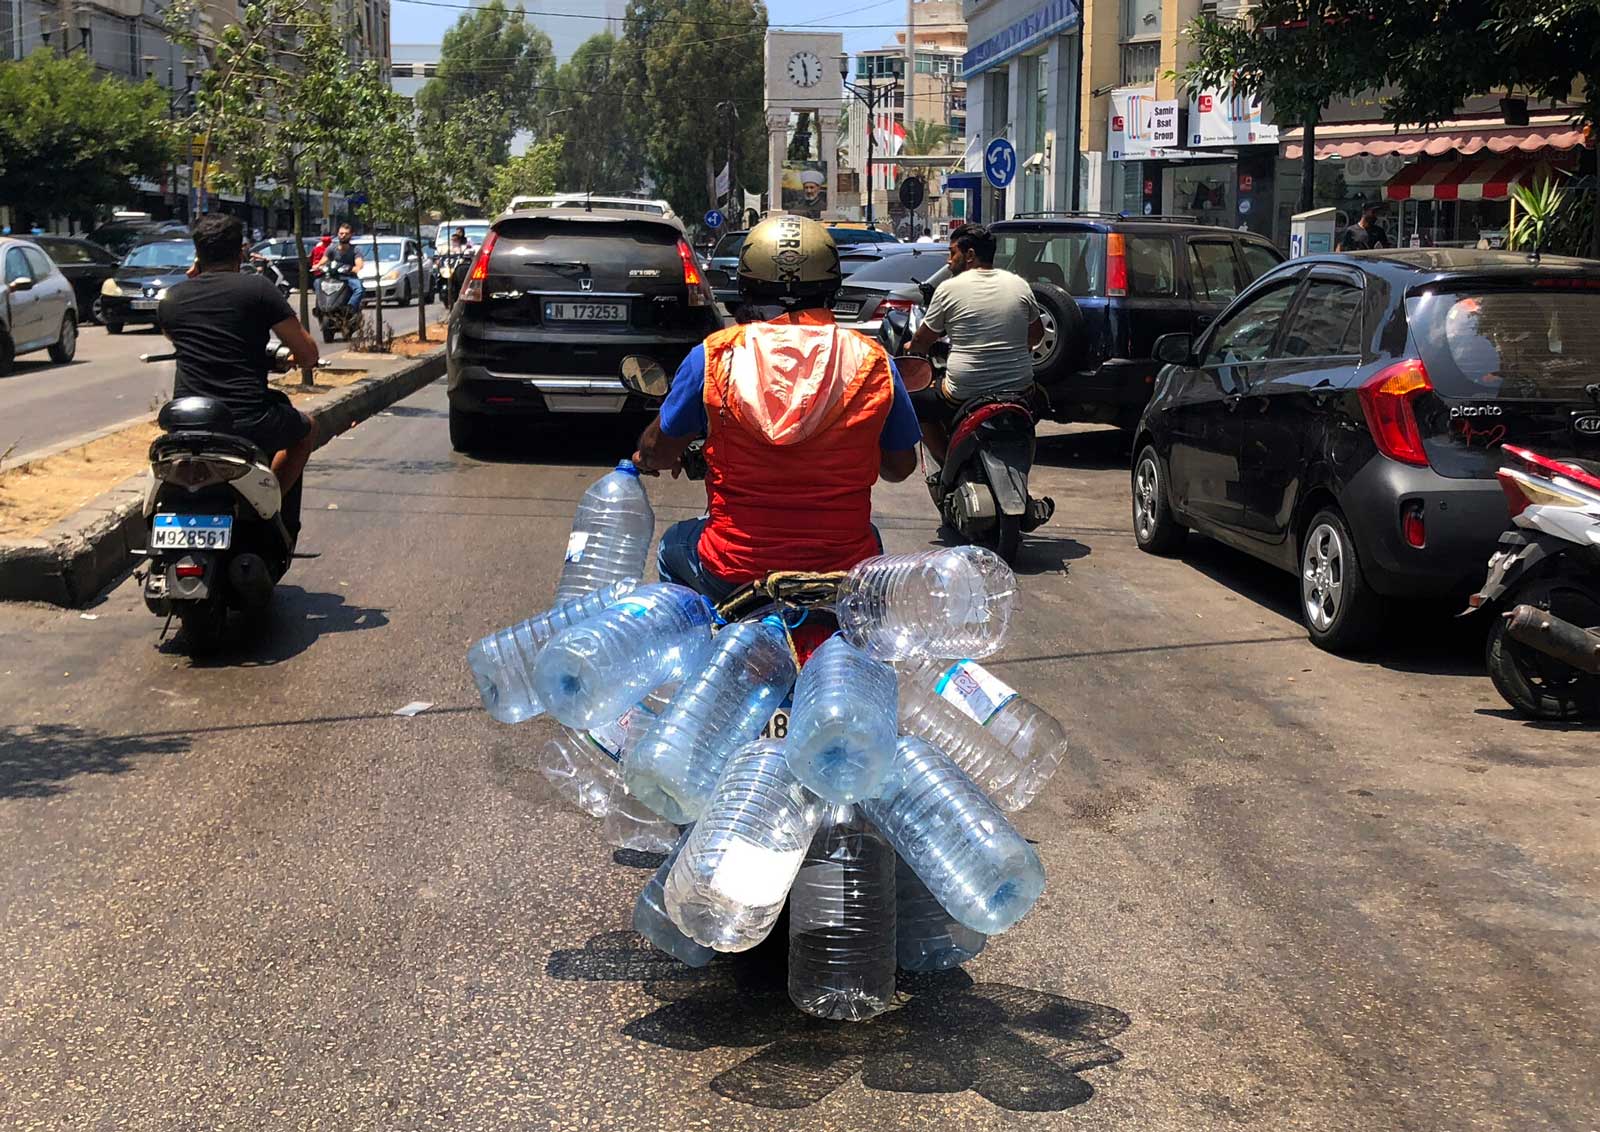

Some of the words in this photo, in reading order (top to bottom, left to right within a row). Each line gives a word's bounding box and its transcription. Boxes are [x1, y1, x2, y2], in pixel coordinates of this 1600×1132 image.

[1154, 106, 1174, 116] Samir
[1156, 119, 1172, 129] Bsat
[1153, 131, 1174, 141] Group
[554, 304, 564, 318] N
[572, 305, 618, 320] 173253
[1450, 406, 1502, 419] picanto
[155, 530, 226, 547] M928561
